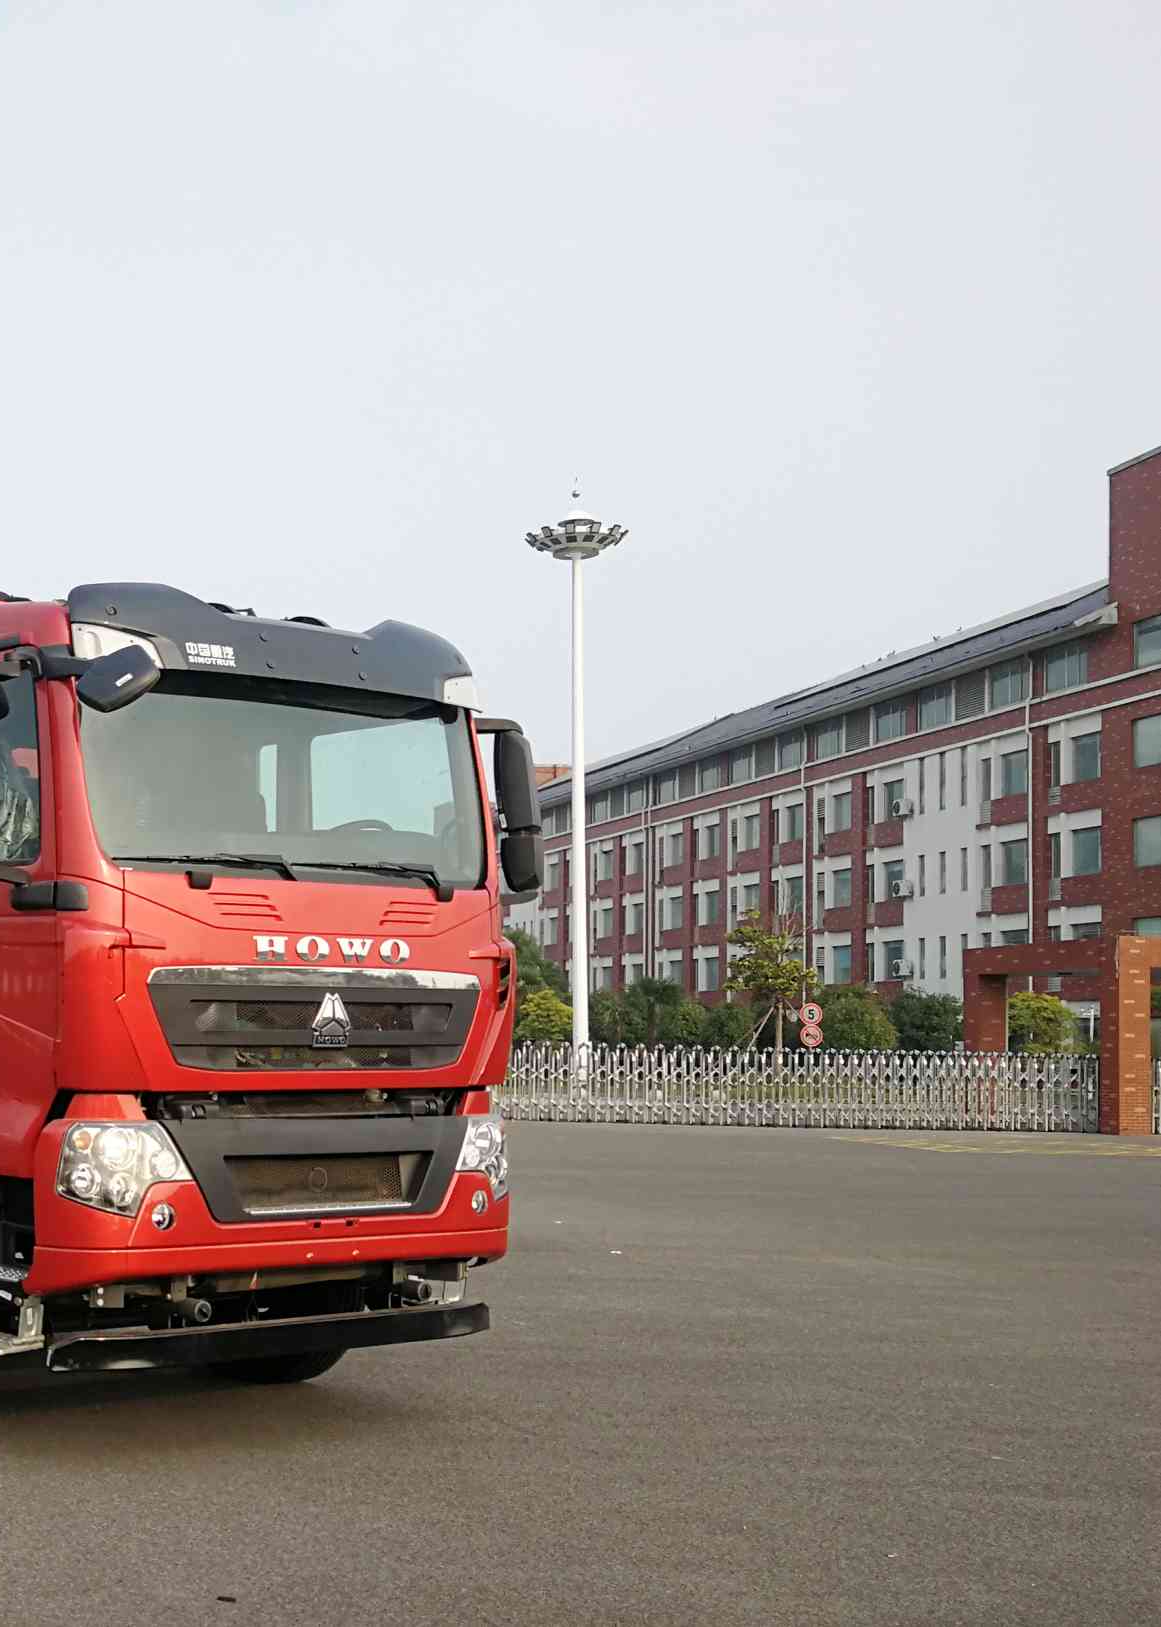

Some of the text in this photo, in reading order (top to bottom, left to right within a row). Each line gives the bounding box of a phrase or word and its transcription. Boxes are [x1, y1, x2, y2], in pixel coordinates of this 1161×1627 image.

[187, 655, 237, 668] SINOTRUK
[252, 935, 411, 964] HOWO
[808, 1008, 815, 1020] 5
